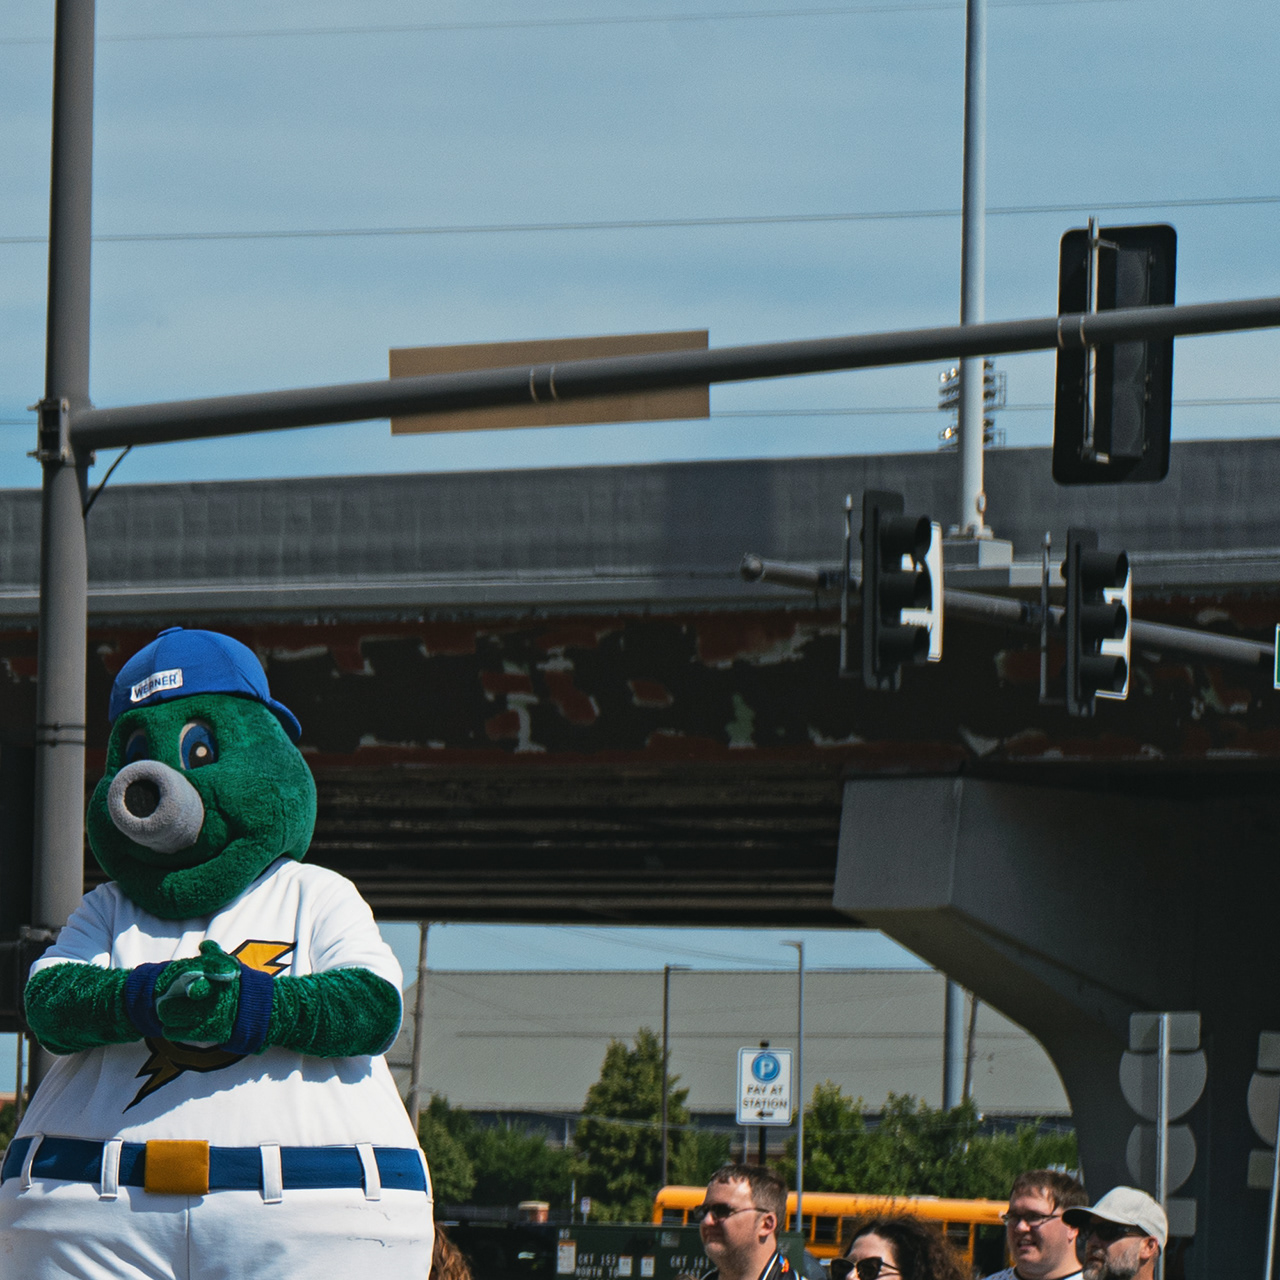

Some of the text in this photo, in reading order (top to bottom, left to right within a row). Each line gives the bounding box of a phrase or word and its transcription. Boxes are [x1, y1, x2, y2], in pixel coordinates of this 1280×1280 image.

[134, 673, 178, 699] WERNER
[760, 1060, 774, 1079] P
[746, 1085, 784, 1095] PAY AT
[742, 1099, 788, 1109] STATION
